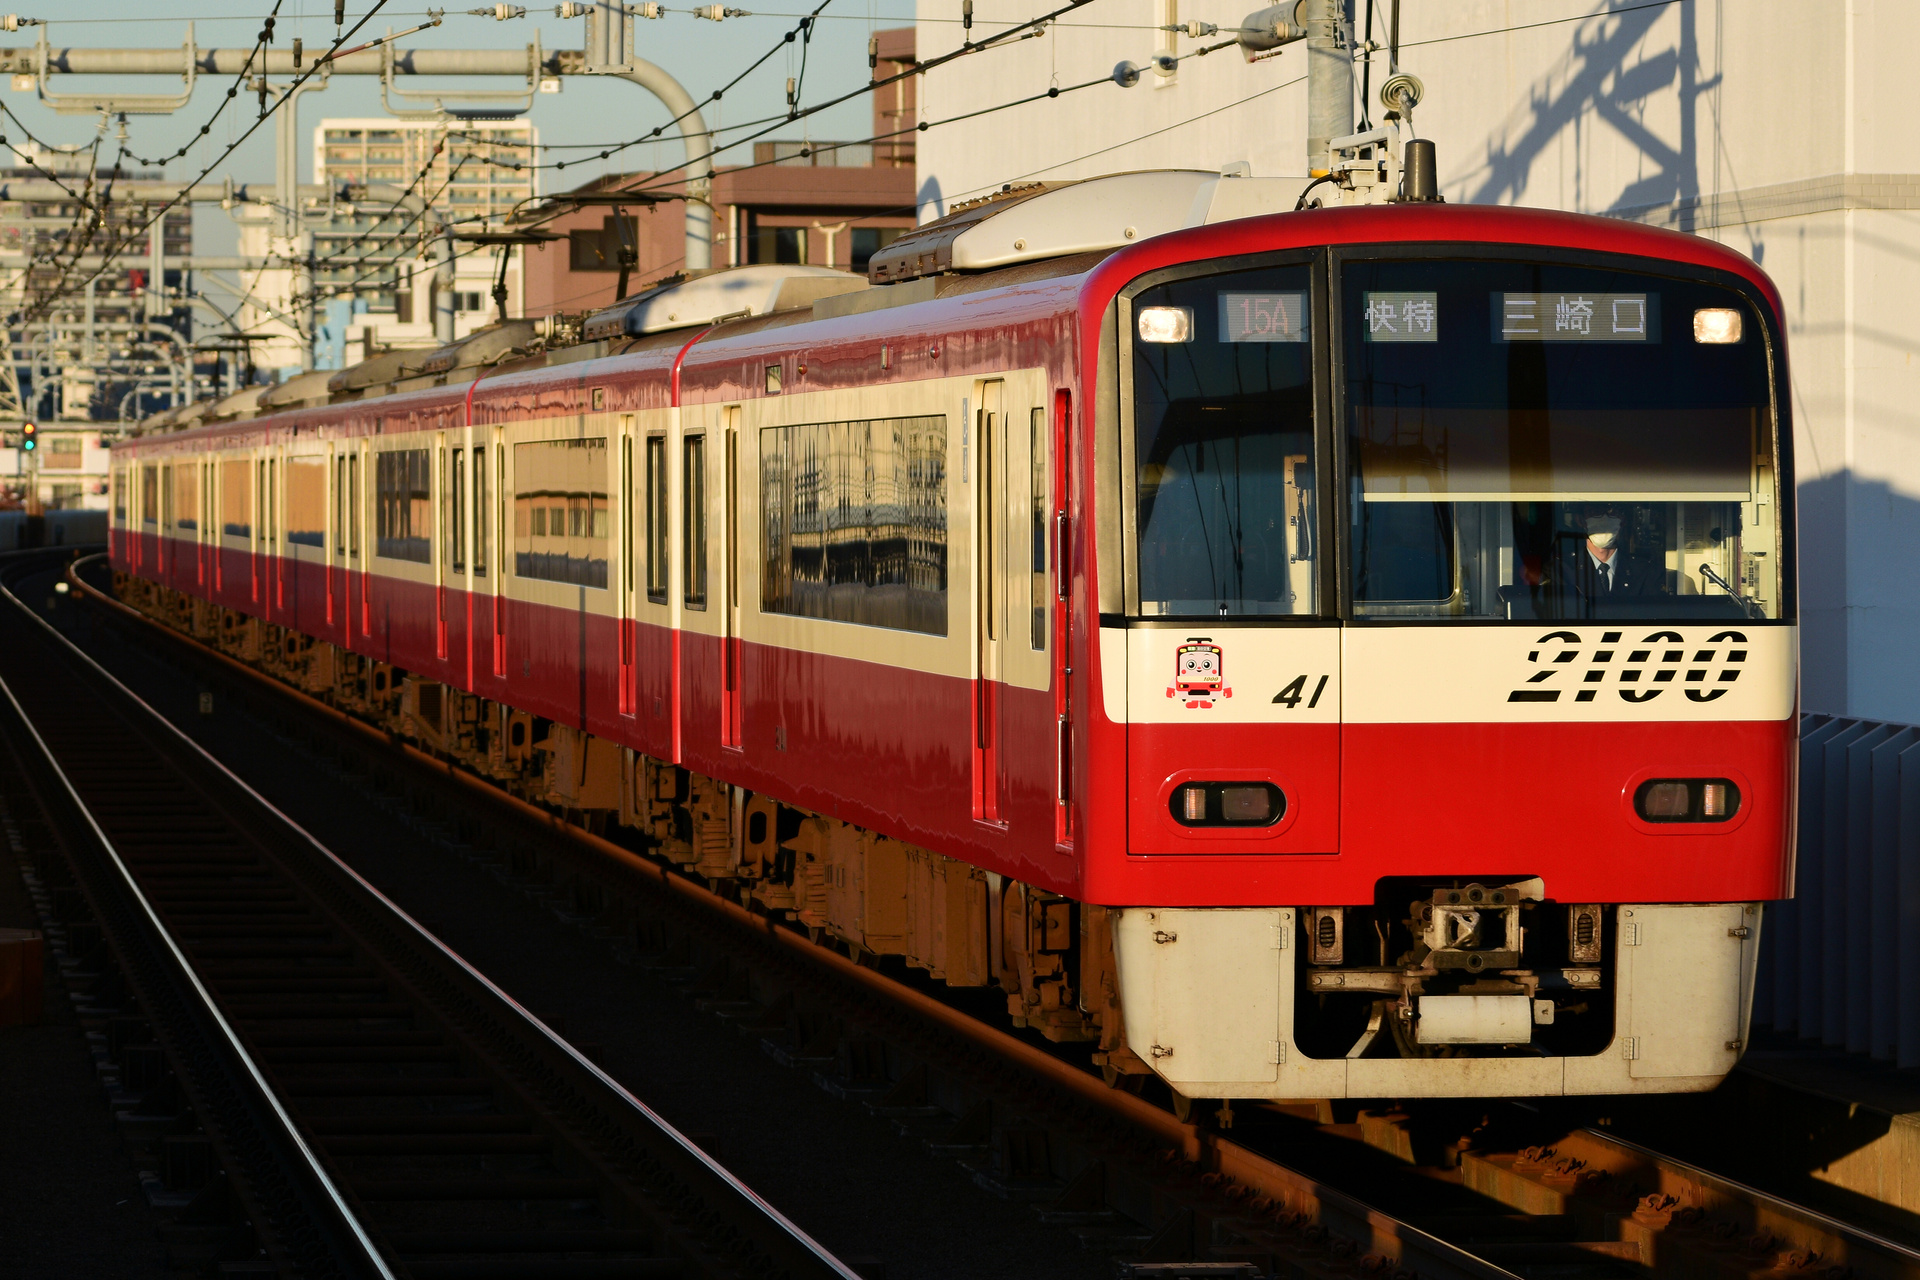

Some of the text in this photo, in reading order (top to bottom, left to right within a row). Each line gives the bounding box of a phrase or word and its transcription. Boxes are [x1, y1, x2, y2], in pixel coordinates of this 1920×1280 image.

[1240, 299, 1288, 335] 15A
[1365, 300, 1434, 332] 快特
[1502, 296, 1645, 334] 三崎口
[1507, 631, 1748, 702] 2100
[1271, 675, 1329, 708] 41
